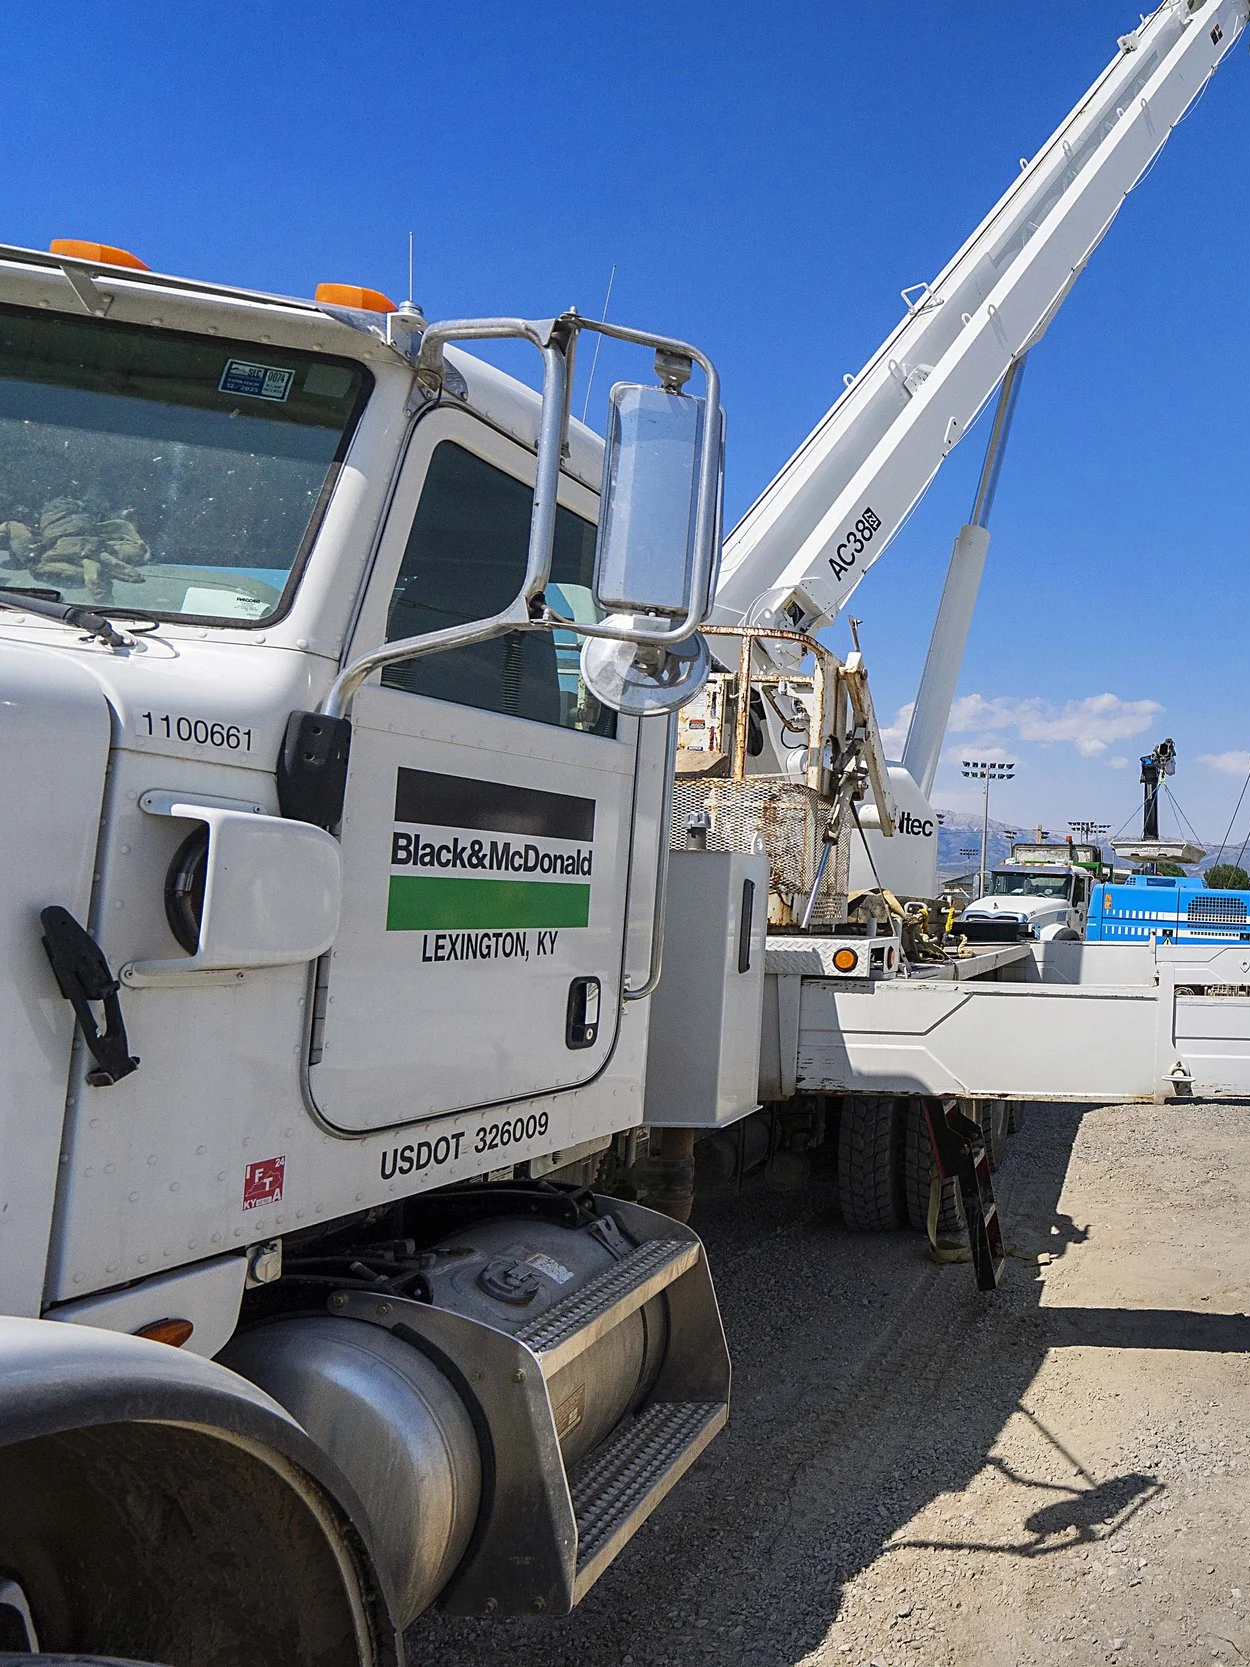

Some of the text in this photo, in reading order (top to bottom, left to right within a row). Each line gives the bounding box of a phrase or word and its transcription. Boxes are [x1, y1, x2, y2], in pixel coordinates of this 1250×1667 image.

[828, 518, 873, 582] AC38
[142, 711, 252, 751] 1100661
[391, 832, 593, 876] Black&McDonald
[422, 930, 559, 963] LEXINGTON, KY
[380, 1111, 550, 1180] USDOT 326009
[243, 1198, 257, 1210] KY
